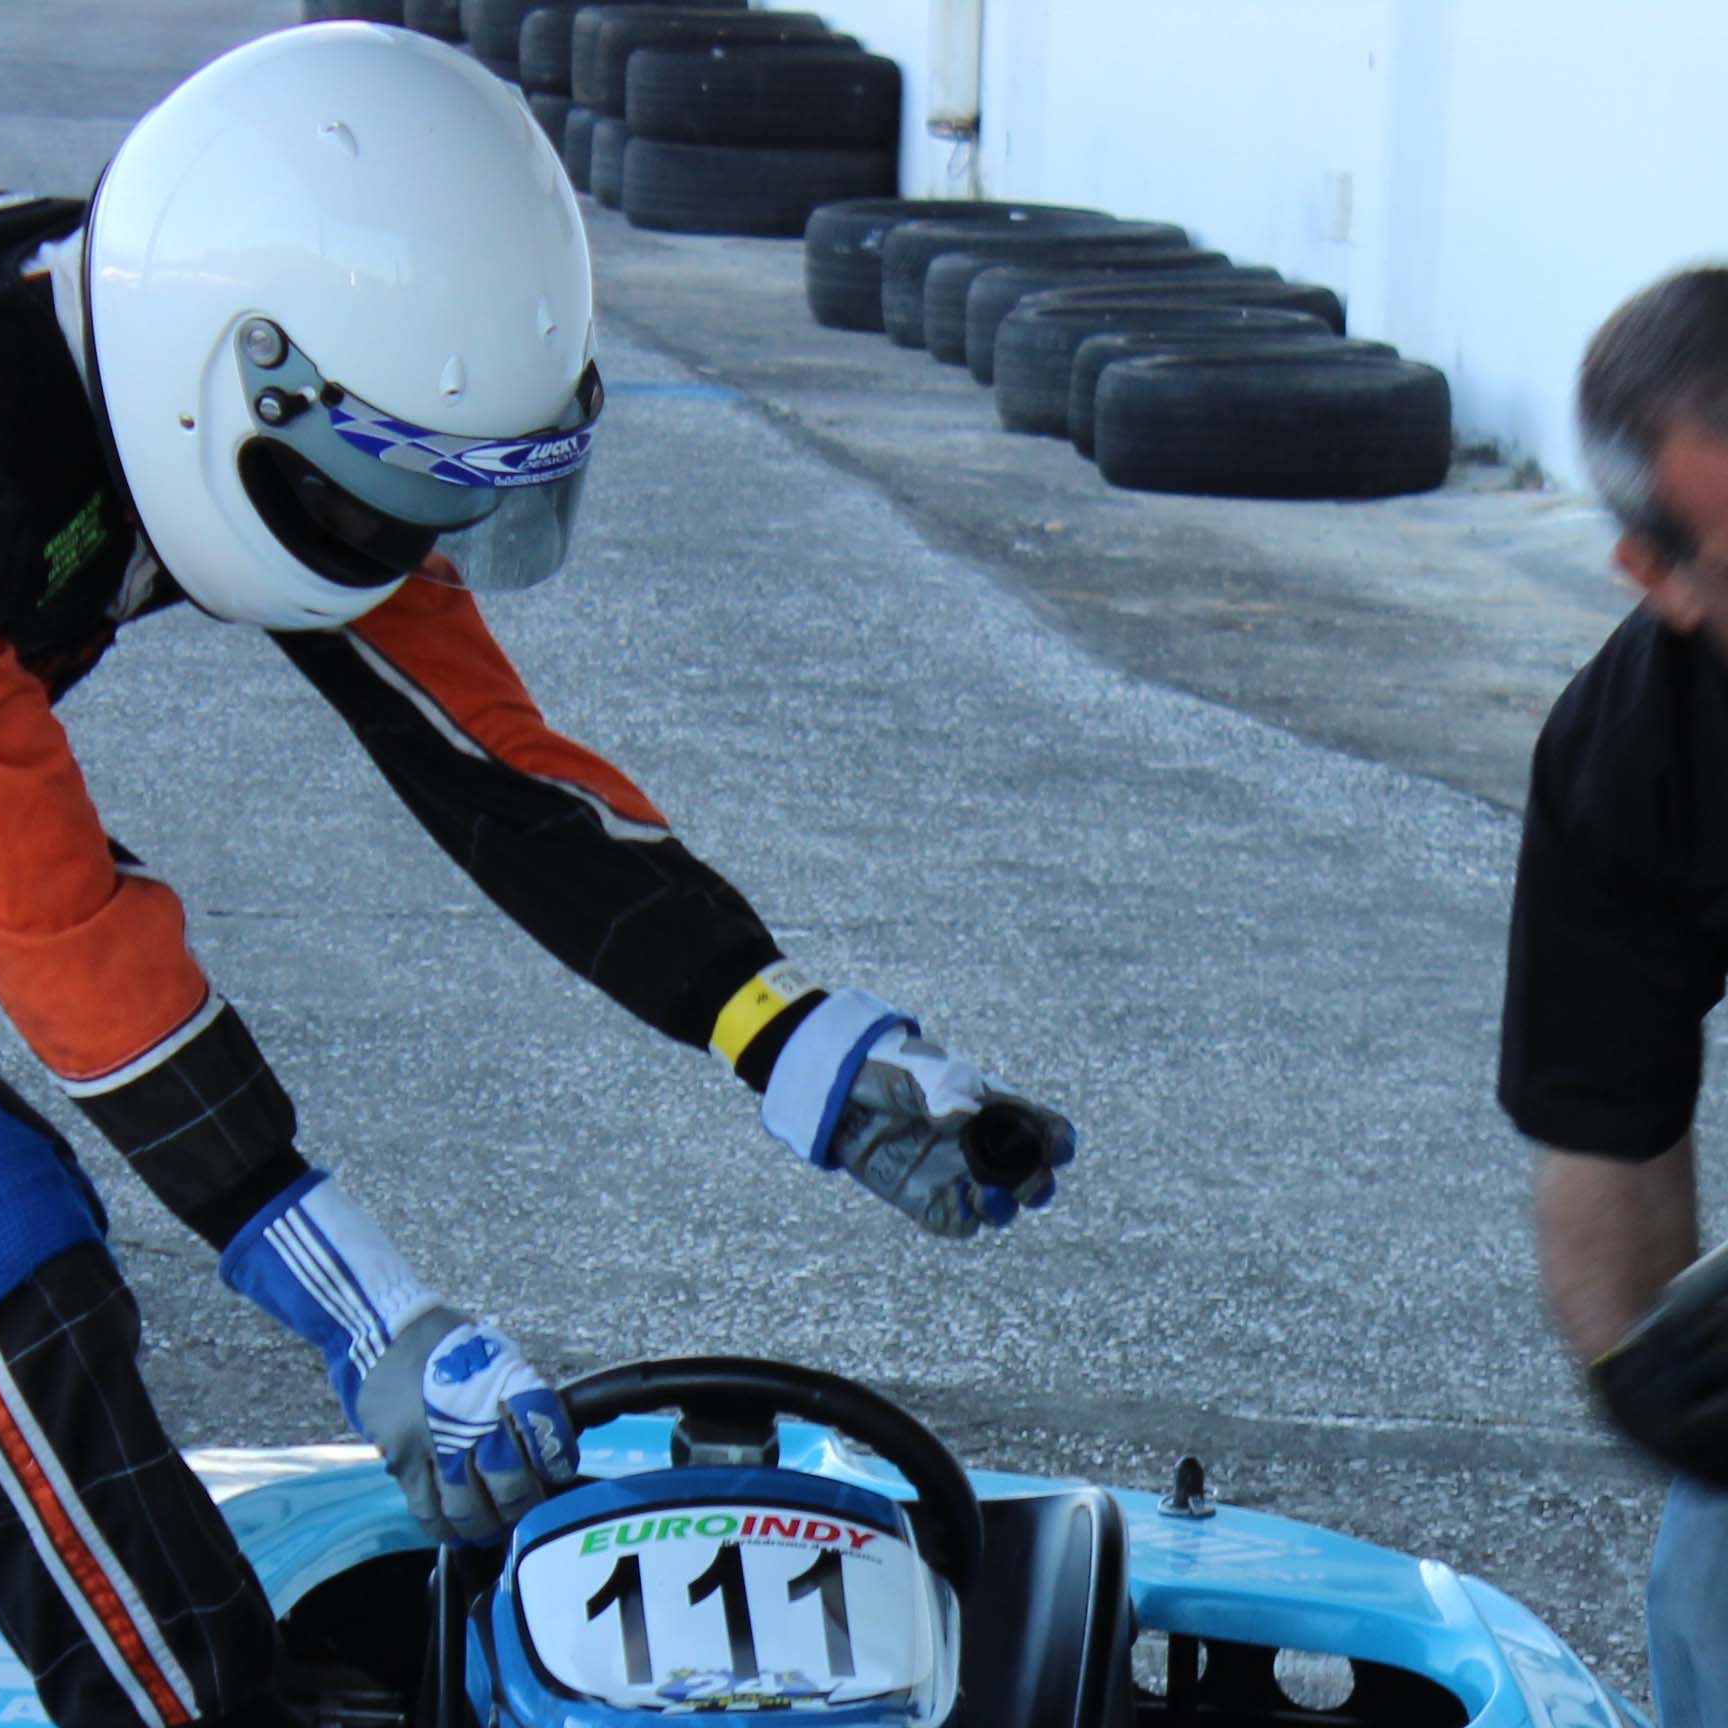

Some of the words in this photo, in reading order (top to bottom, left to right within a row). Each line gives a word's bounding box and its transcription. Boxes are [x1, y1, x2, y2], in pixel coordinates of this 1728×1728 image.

[526, 436, 578, 461] LUCKY
[579, 1513, 877, 1558] EUROINDY
[585, 1539, 857, 1686] 111
